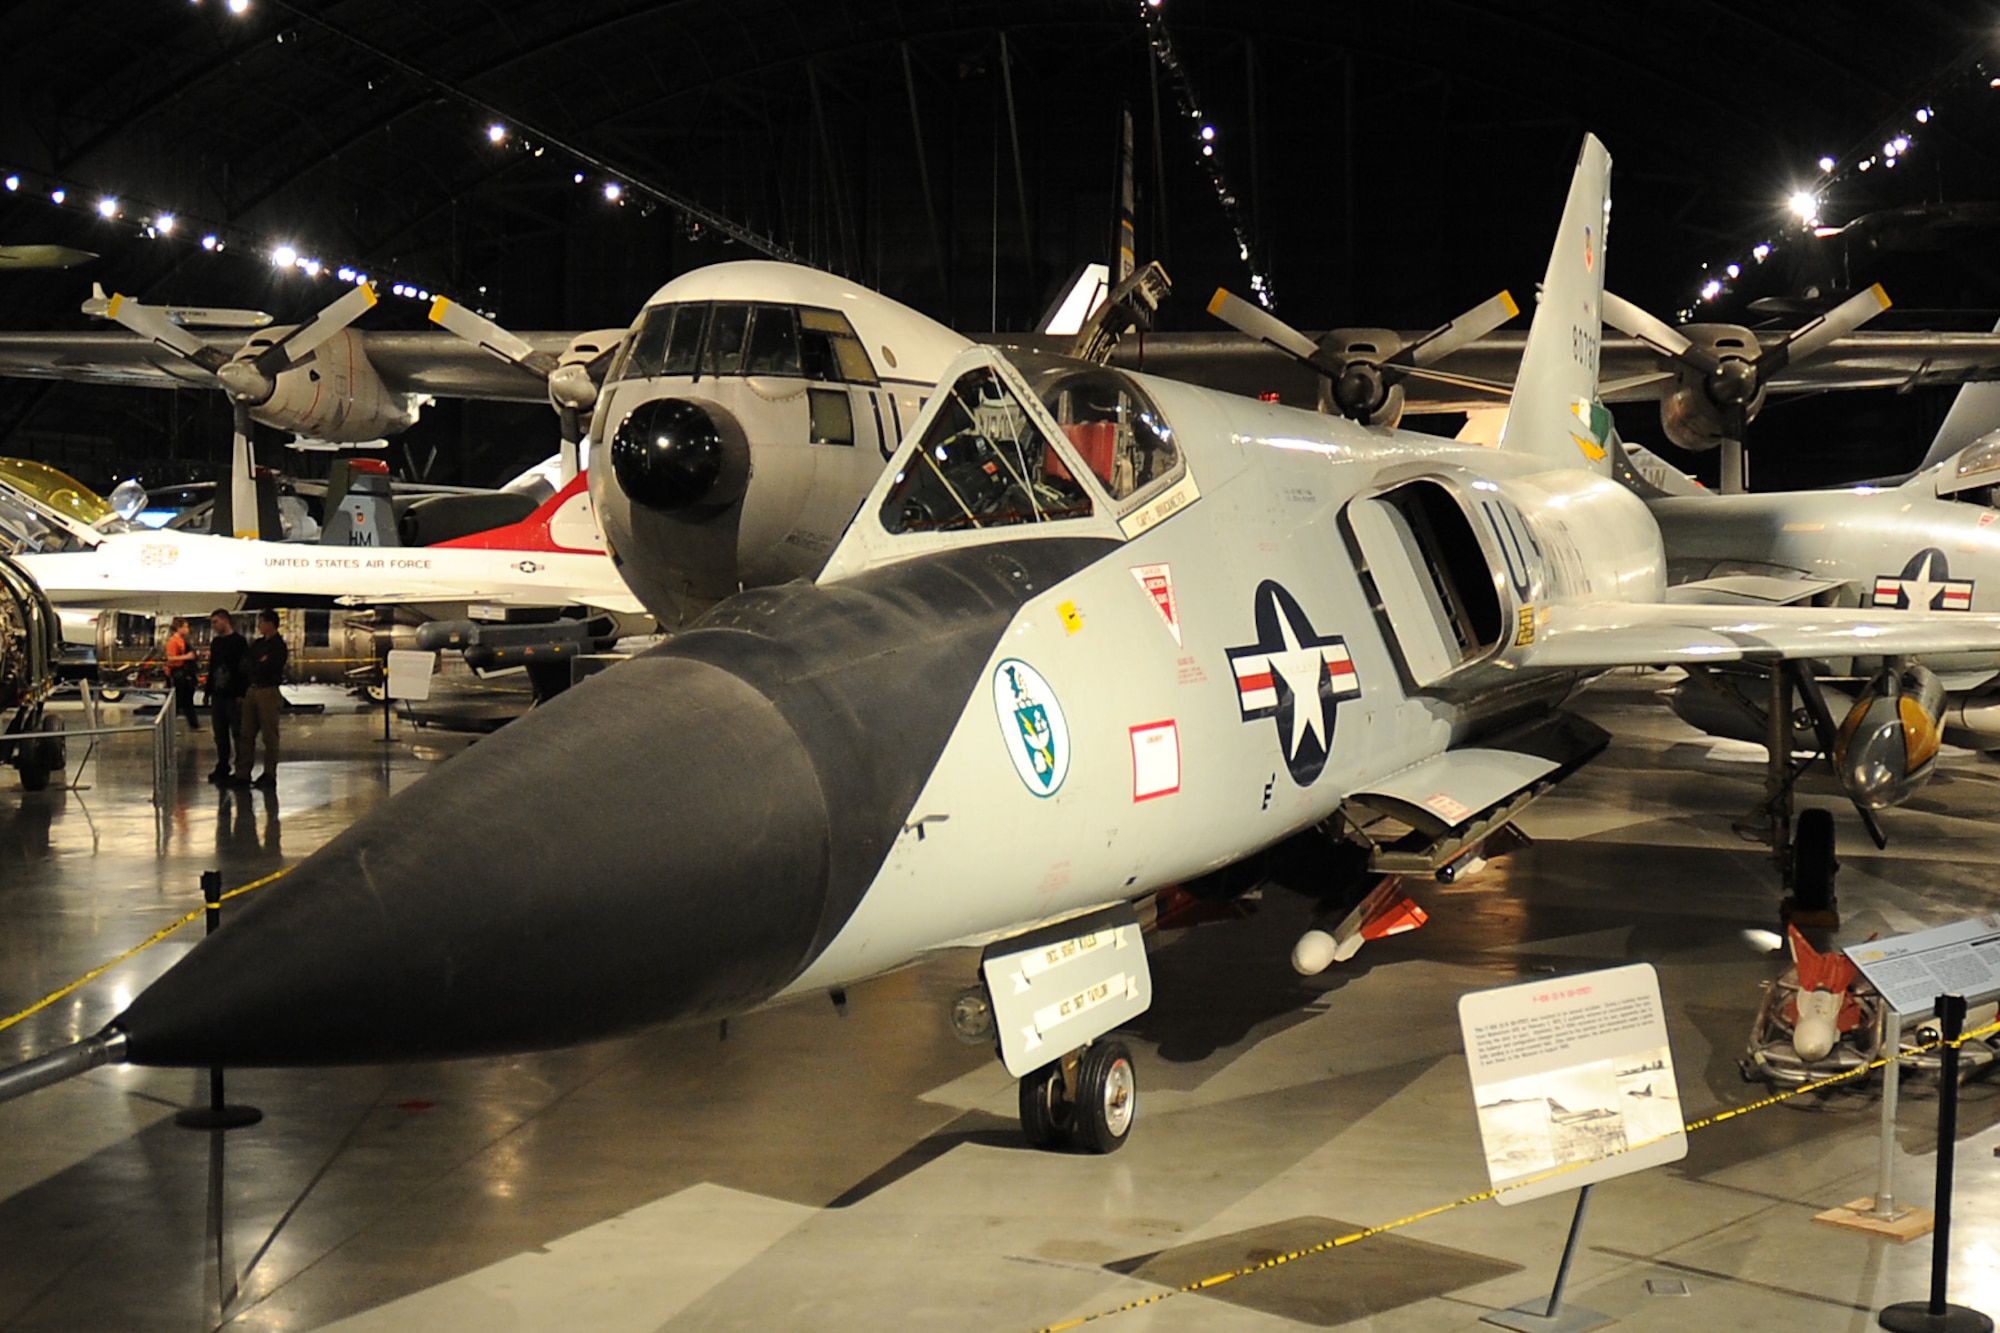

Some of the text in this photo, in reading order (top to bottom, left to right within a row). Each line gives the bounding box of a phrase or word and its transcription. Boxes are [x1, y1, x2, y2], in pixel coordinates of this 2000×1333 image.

[348, 530, 373, 547] HM
[264, 557, 431, 570] UNITED STATES AIR FORCE
